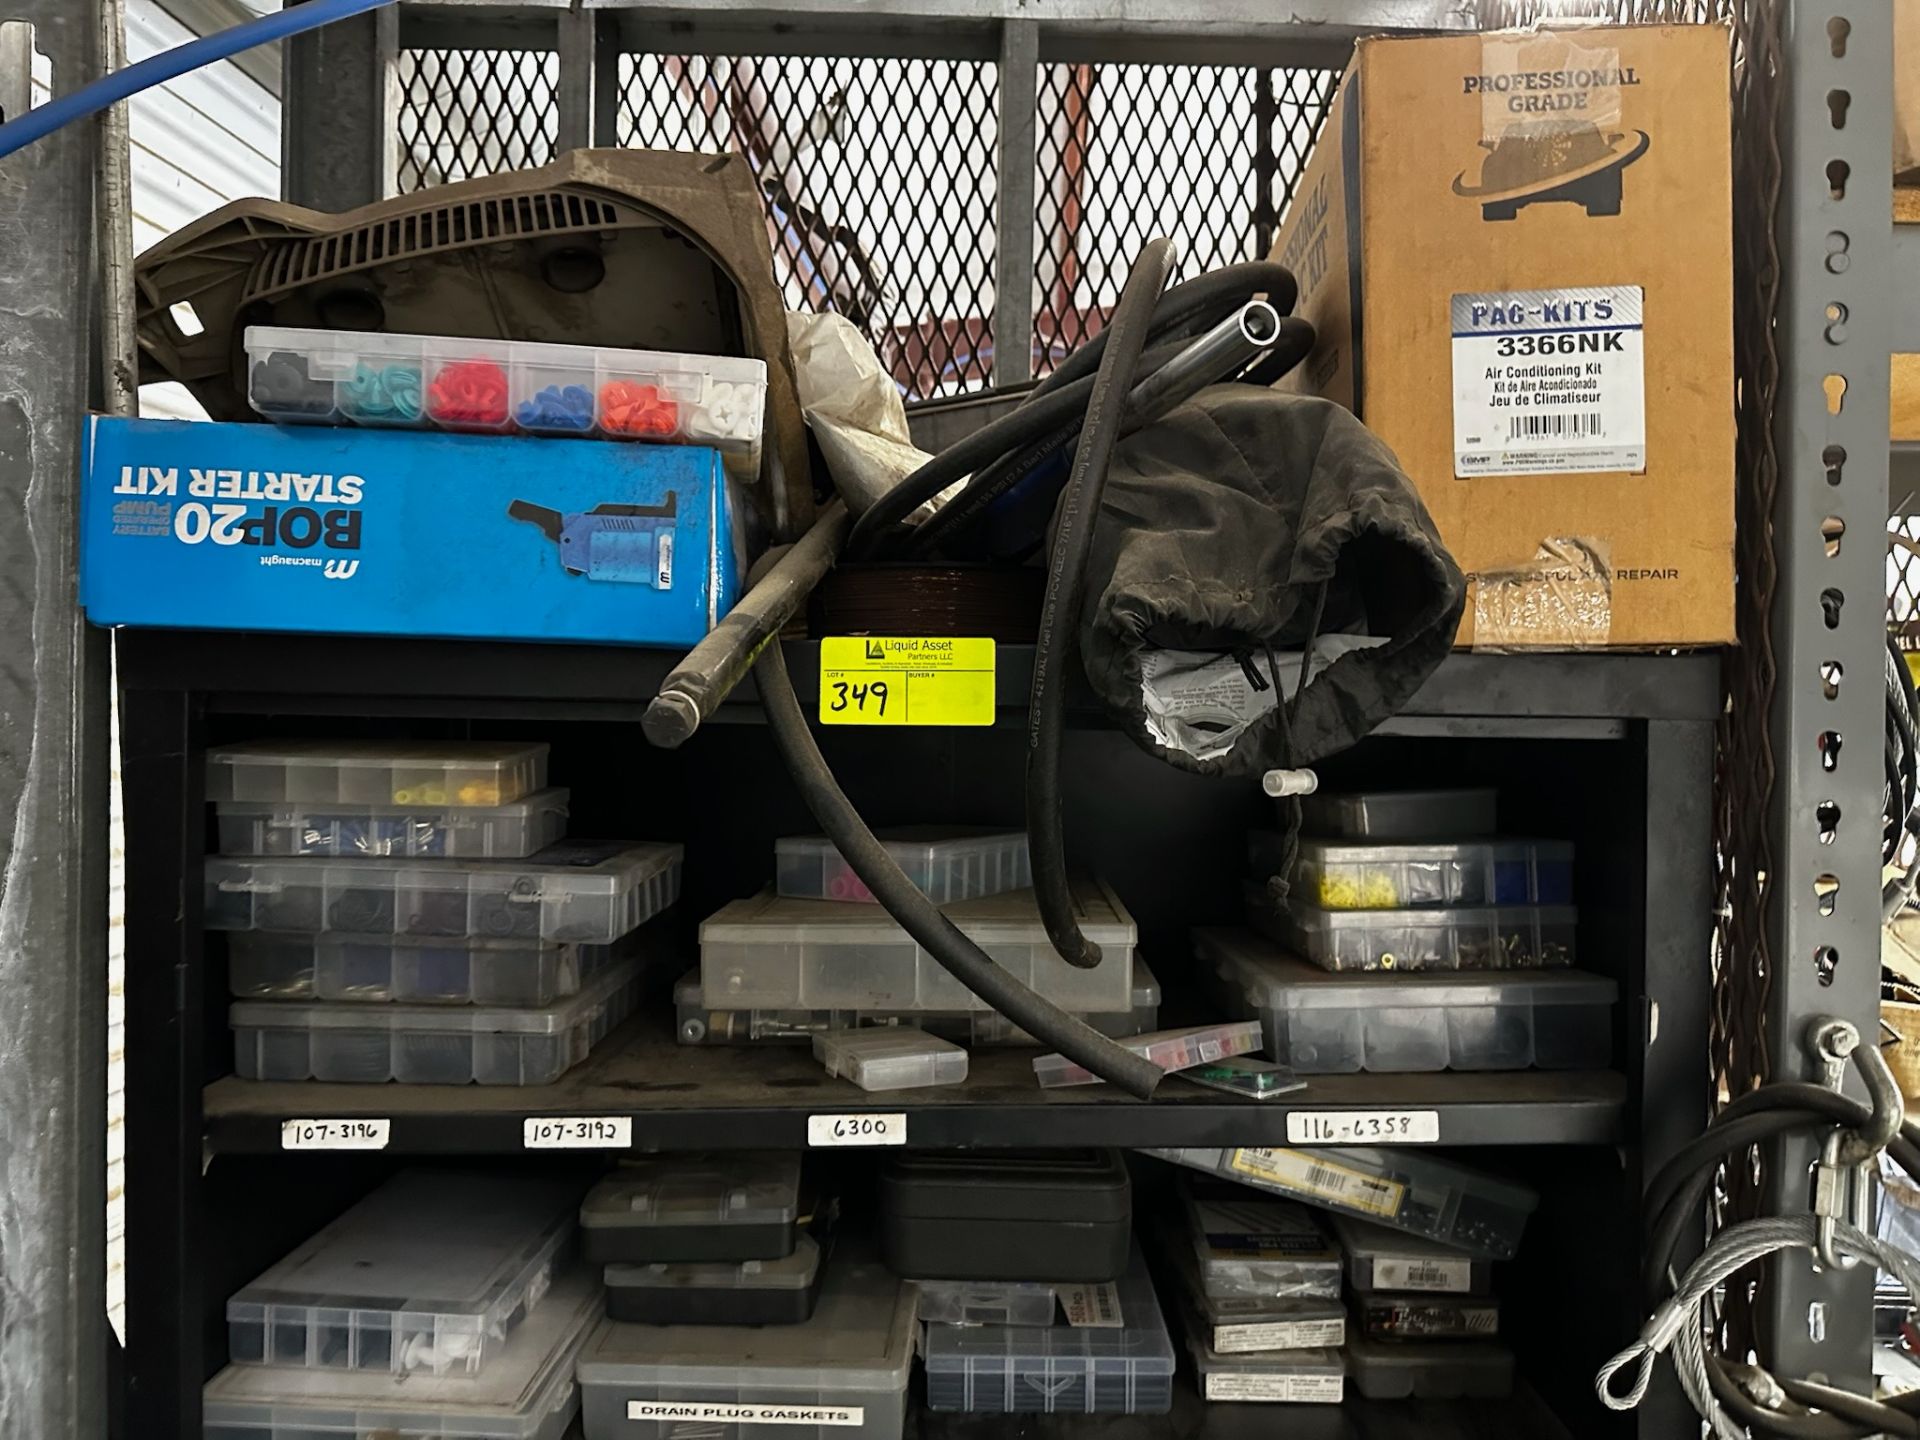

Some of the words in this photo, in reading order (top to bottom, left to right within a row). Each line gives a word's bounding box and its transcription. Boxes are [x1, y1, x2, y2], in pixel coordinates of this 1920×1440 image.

[1463, 68, 1640, 93] PROFESSIONAL
[1508, 92, 1587, 113] GRADE
[1497, 332, 1624, 357] 3366NK
[1485, 367, 1502, 379] Air
[1506, 364, 1581, 379] Conditioning
[1586, 363, 1602, 375] Kit
[1494, 381, 1505, 393] Kit
[1507, 381, 1518, 393] de
[1520, 380, 1536, 392] Aire
[1539, 378, 1597, 391] Acondicionado
[1489, 395, 1511, 407] Jeu
[1515, 394, 1529, 406] de
[1534, 392, 1602, 405] Climatiseur
[113, 466, 178, 496] KIT
[189, 469, 366, 504] STARTER
[112, 501, 171, 514] PUMP
[112, 525, 170, 536] BATTERY
[174, 502, 363, 550] BOP20
[260, 555, 322, 567] macnaught
[1617, 569, 1679, 581] REPAIR
[1046, 603, 1056, 627] Line
[885, 640, 918, 652] Liquid
[922, 640, 953, 651] Asset
[1042, 632, 1051, 654] Fuel
[831, 682, 888, 717] 349
[296, 1123, 378, 1144] 107-3196
[533, 1121, 617, 1141] 107-3192
[834, 1119, 886, 1137] 6300
[1304, 1117, 1411, 1139] 116-6358
[641, 1406, 697, 1416] DRAIN
[704, 1408, 754, 1418] PLUG
[760, 1410, 849, 1420] GASKETS
